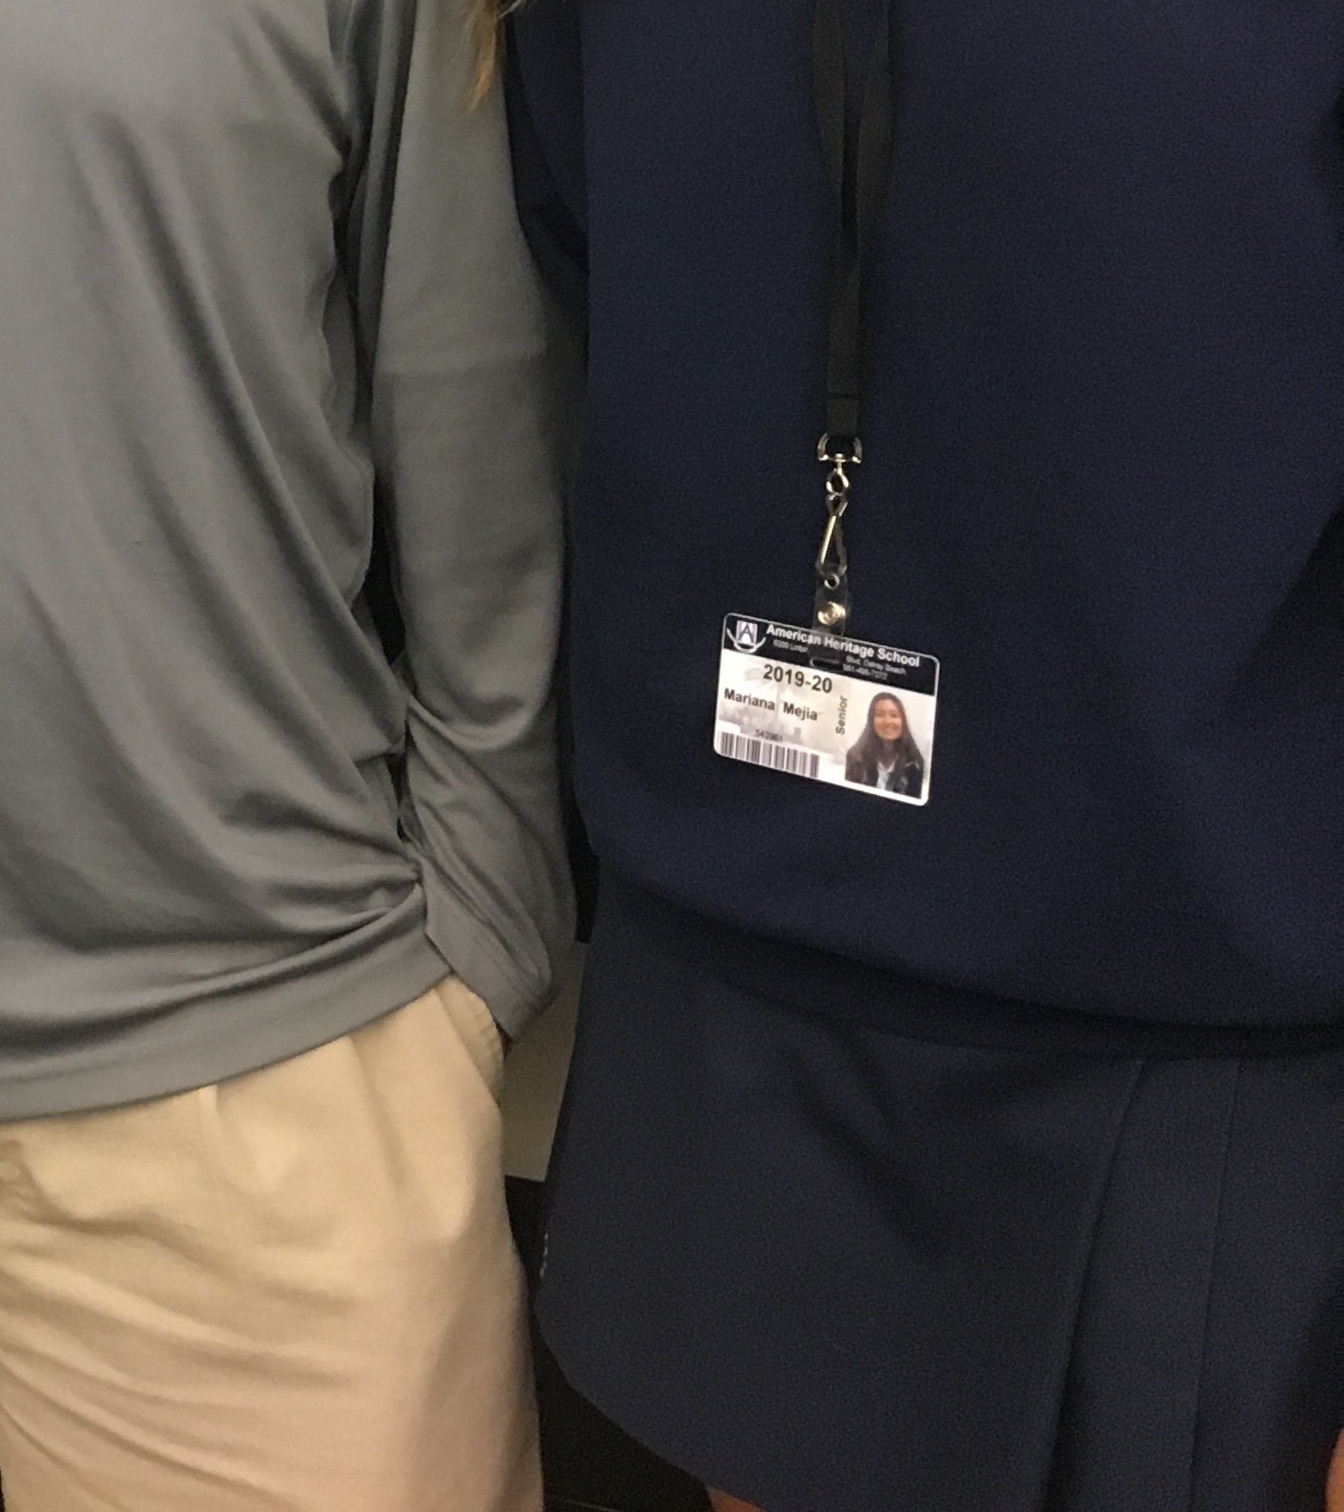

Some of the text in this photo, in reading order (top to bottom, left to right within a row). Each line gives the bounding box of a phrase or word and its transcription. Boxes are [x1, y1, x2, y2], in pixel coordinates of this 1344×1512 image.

[766, 624, 822, 646] American
[824, 635, 875, 659] Heritage
[877, 648, 920, 667] School
[763, 663, 833, 694] 2019-20
[723, 688, 818, 722] Mariana Mejia
[835, 695, 849, 735] Senior
